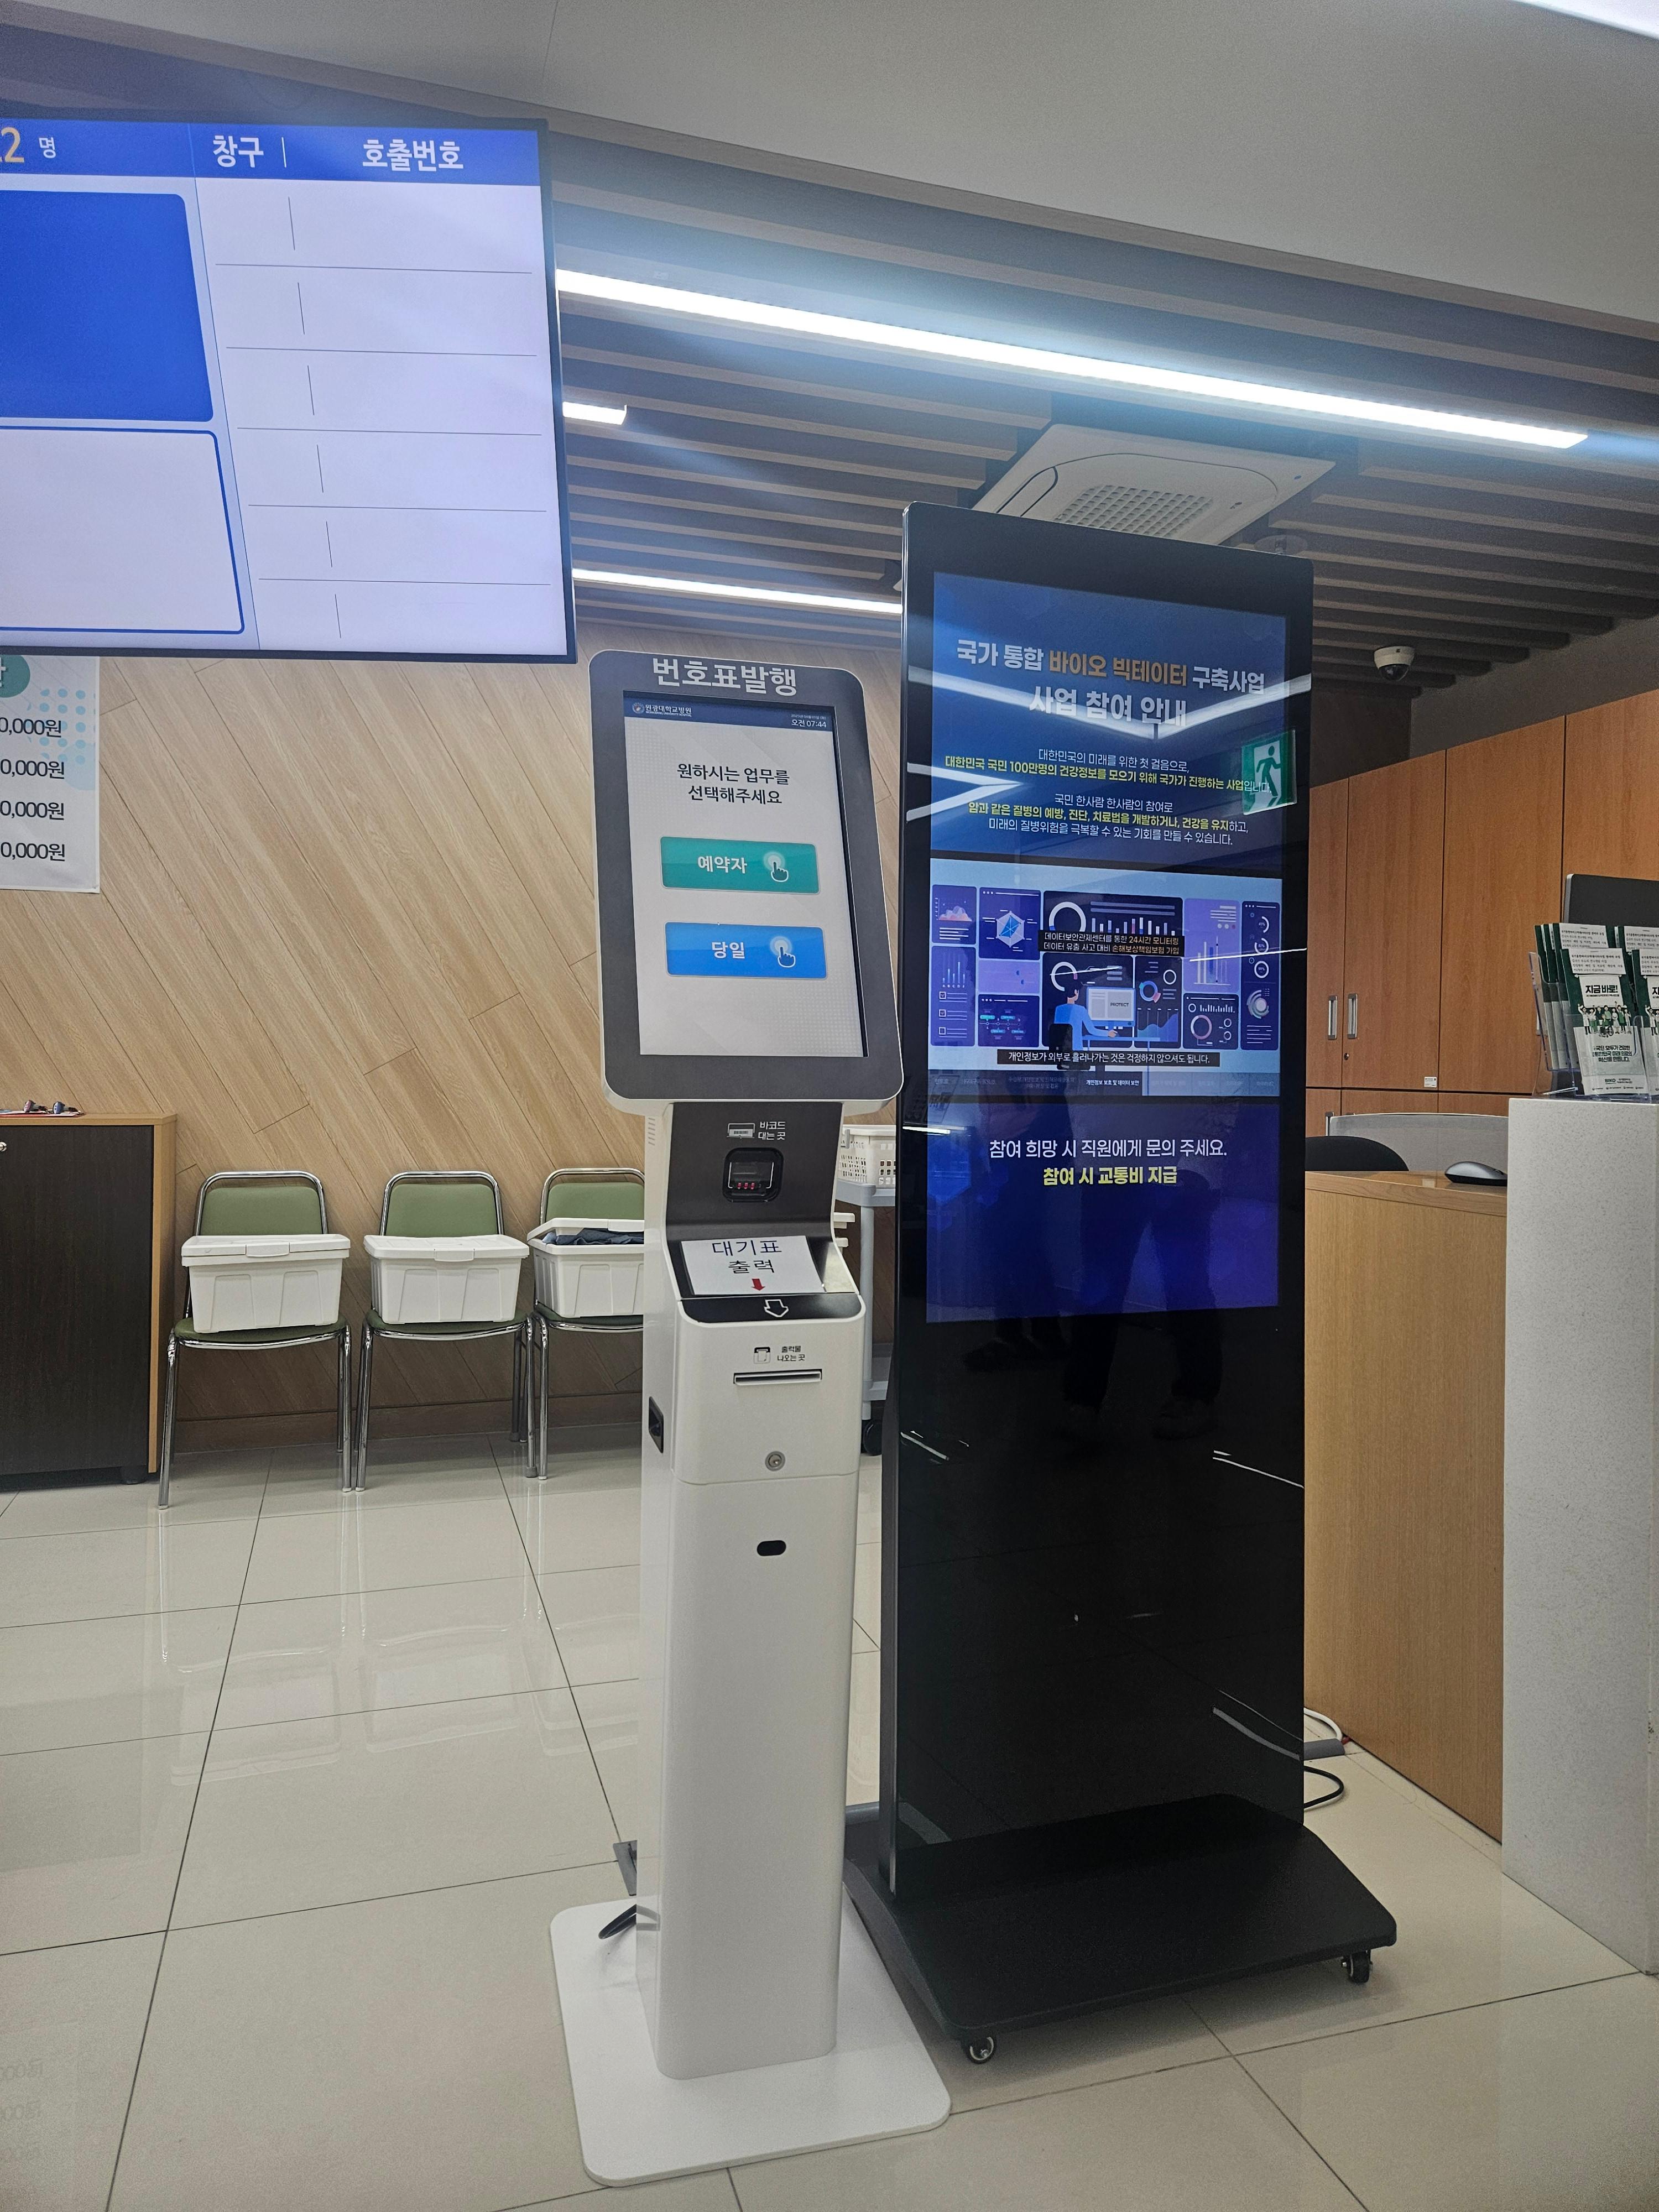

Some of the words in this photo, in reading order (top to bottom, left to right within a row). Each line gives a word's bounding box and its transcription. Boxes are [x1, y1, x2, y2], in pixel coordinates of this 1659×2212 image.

[0, 127, 24, 163] 2
[39, 137, 56, 159] 명
[212, 134, 264, 168] 창구
[362, 139, 465, 172] 호출번호
[957, 639, 999, 666] 국가
[1004, 644, 1044, 671] 통합
[1049, 650, 1107, 677] 바이오
[1192, 666, 1265, 695] 구축사업
[653, 658, 797, 697] 번호표발행
[645, 705, 691, 714] 원광대학교병원
[1029, 686, 1077, 717] 사업
[1086, 691, 1132, 722] 참여
[1140, 697, 1186, 727] 안내
[0, 717, 62, 738] 0,000원
[791, 719, 805, 727] 오전
[0, 759, 65, 779] 0,000원
[1039, 749, 1086, 764] 대한민국의
[1089, 754, 1117, 766] 미래를
[1119, 756, 1138, 768] 위한
[1140, 758, 1149, 769] 첫
[1151, 759, 1190, 774] 걸음으로,
[677, 763, 739, 782] 원하시는
[744, 766, 790, 786] 업무를
[945, 755, 985, 770] 대한민국
[988, 759, 1007, 771] 국민
[1010, 761, 1057, 776] 100만명의
[1060, 765, 1106, 780] 건강정보를
[1109, 769, 1136, 782] 모으기
[1139, 773, 1157, 784] 위해
[1160, 774, 1186, 786] 국가가
[1189, 776, 1224, 789] 진행하는
[1226, 779, 1272, 793] 사업입니다.
[688, 785, 782, 805] 선택해주세요
[1055, 794, 1073, 806] 국민
[1076, 795, 1104, 808] 한사람
[1107, 797, 1142, 811] 한사람의
[1146, 801, 1173, 813] 참여로
[0, 800, 64, 821] 0,000원
[968, 802, 989, 814] 암과
[991, 804, 1010, 816] 같은
[1013, 805, 1042, 818] 질병의
[1045, 807, 1066, 821] 예방,
[1069, 809, 1090, 822] 진단,
[1093, 811, 1129, 824] 치료법을
[1132, 813, 1180, 828] 개발하거나,
[1182, 817, 1209, 830] 건강을
[1211, 820, 1248, 833] 유지하고,
[989, 818, 1017, 831] 미래의
[1021, 820, 1068, 834] 질병위험을
[1071, 823, 1099, 836] 극복할
[1102, 826, 1110, 837] 수
[1113, 827, 1132, 838] 있는
[1134, 828, 1161, 841] 기회를
[1164, 830, 1182, 842] 만들
[1184, 831, 1193, 843] 수
[1196, 832, 1233, 845] 있습니다.
[1, 842, 65, 862] 0,000원
[698, 855, 747, 874] 예약자
[1044, 942, 1065, 951] 데이터
[1066, 943, 1080, 951] 유출
[1082, 943, 1095, 952] 사고
[1097, 944, 1110, 952] 대비
[1112, 945, 1165, 954] 손해보상책임보험
[1166, 946, 1180, 955] 가입
[1045, 932, 1112, 943] 데이터보안관제센터를
[1114, 935, 1128, 943] 통한
[1129, 935, 1151, 945] 24시간
[1153, 937, 1179, 945] 모니터링
[712, 942, 745, 959] 당일
[1585, 985, 1601, 993] 지금
[1008, 1052, 1047, 1062] 개인정보가
[1048, 1052, 1071, 1062] 외부로
[1072, 1052, 1109, 1063] 흘러나가는
[1110, 1053, 1125, 1063] 것은
[1126, 1053, 1156, 1063] 걱정하지
[1157, 1053, 1186, 1063] 않으셔도
[1187, 1053, 1210, 1064] 됩니다.
[760, 1121, 785, 1130] 바코드
[989, 1140, 1021, 1158] 참여
[1026, 1139, 1057, 1157] 희망
[1062, 1140, 1077, 1157] 시
[1081, 1139, 1142, 1157] 직원에게
[1146, 1139, 1176, 1157] 문의
[1180, 1139, 1227, 1156] 주세요.
[1044, 1167, 1074, 1185] 참여
[1078, 1167, 1093, 1185] 시
[1098, 1166, 1143, 1185] 교통비
[1147, 1166, 1178, 1184] 지급
[712, 1239, 782, 1258] 대기표
[728, 1258, 775, 1274] 출력
